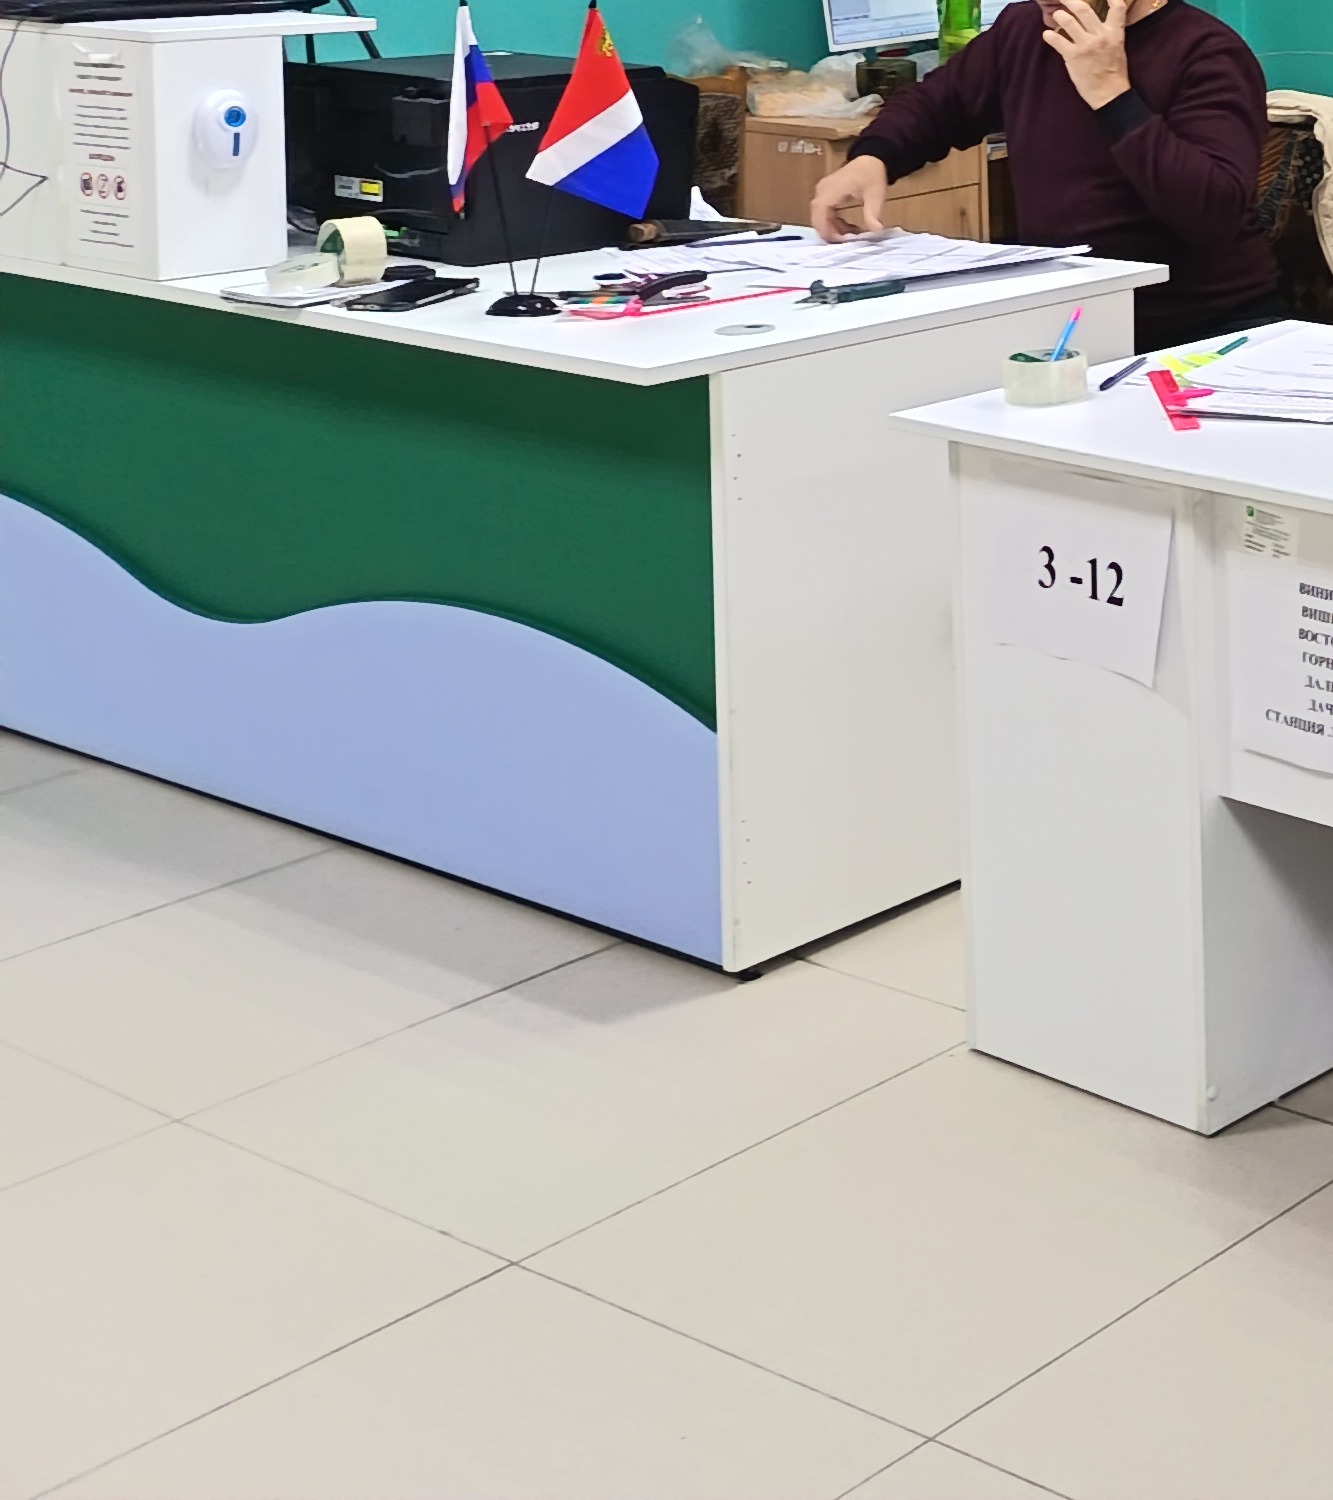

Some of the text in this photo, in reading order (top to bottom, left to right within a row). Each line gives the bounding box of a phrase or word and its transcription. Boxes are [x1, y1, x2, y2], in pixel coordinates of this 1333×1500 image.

[1037, 545, 1125, 607] 3 -12
[1265, 708, 1325, 737] СТАНЦИЯ
